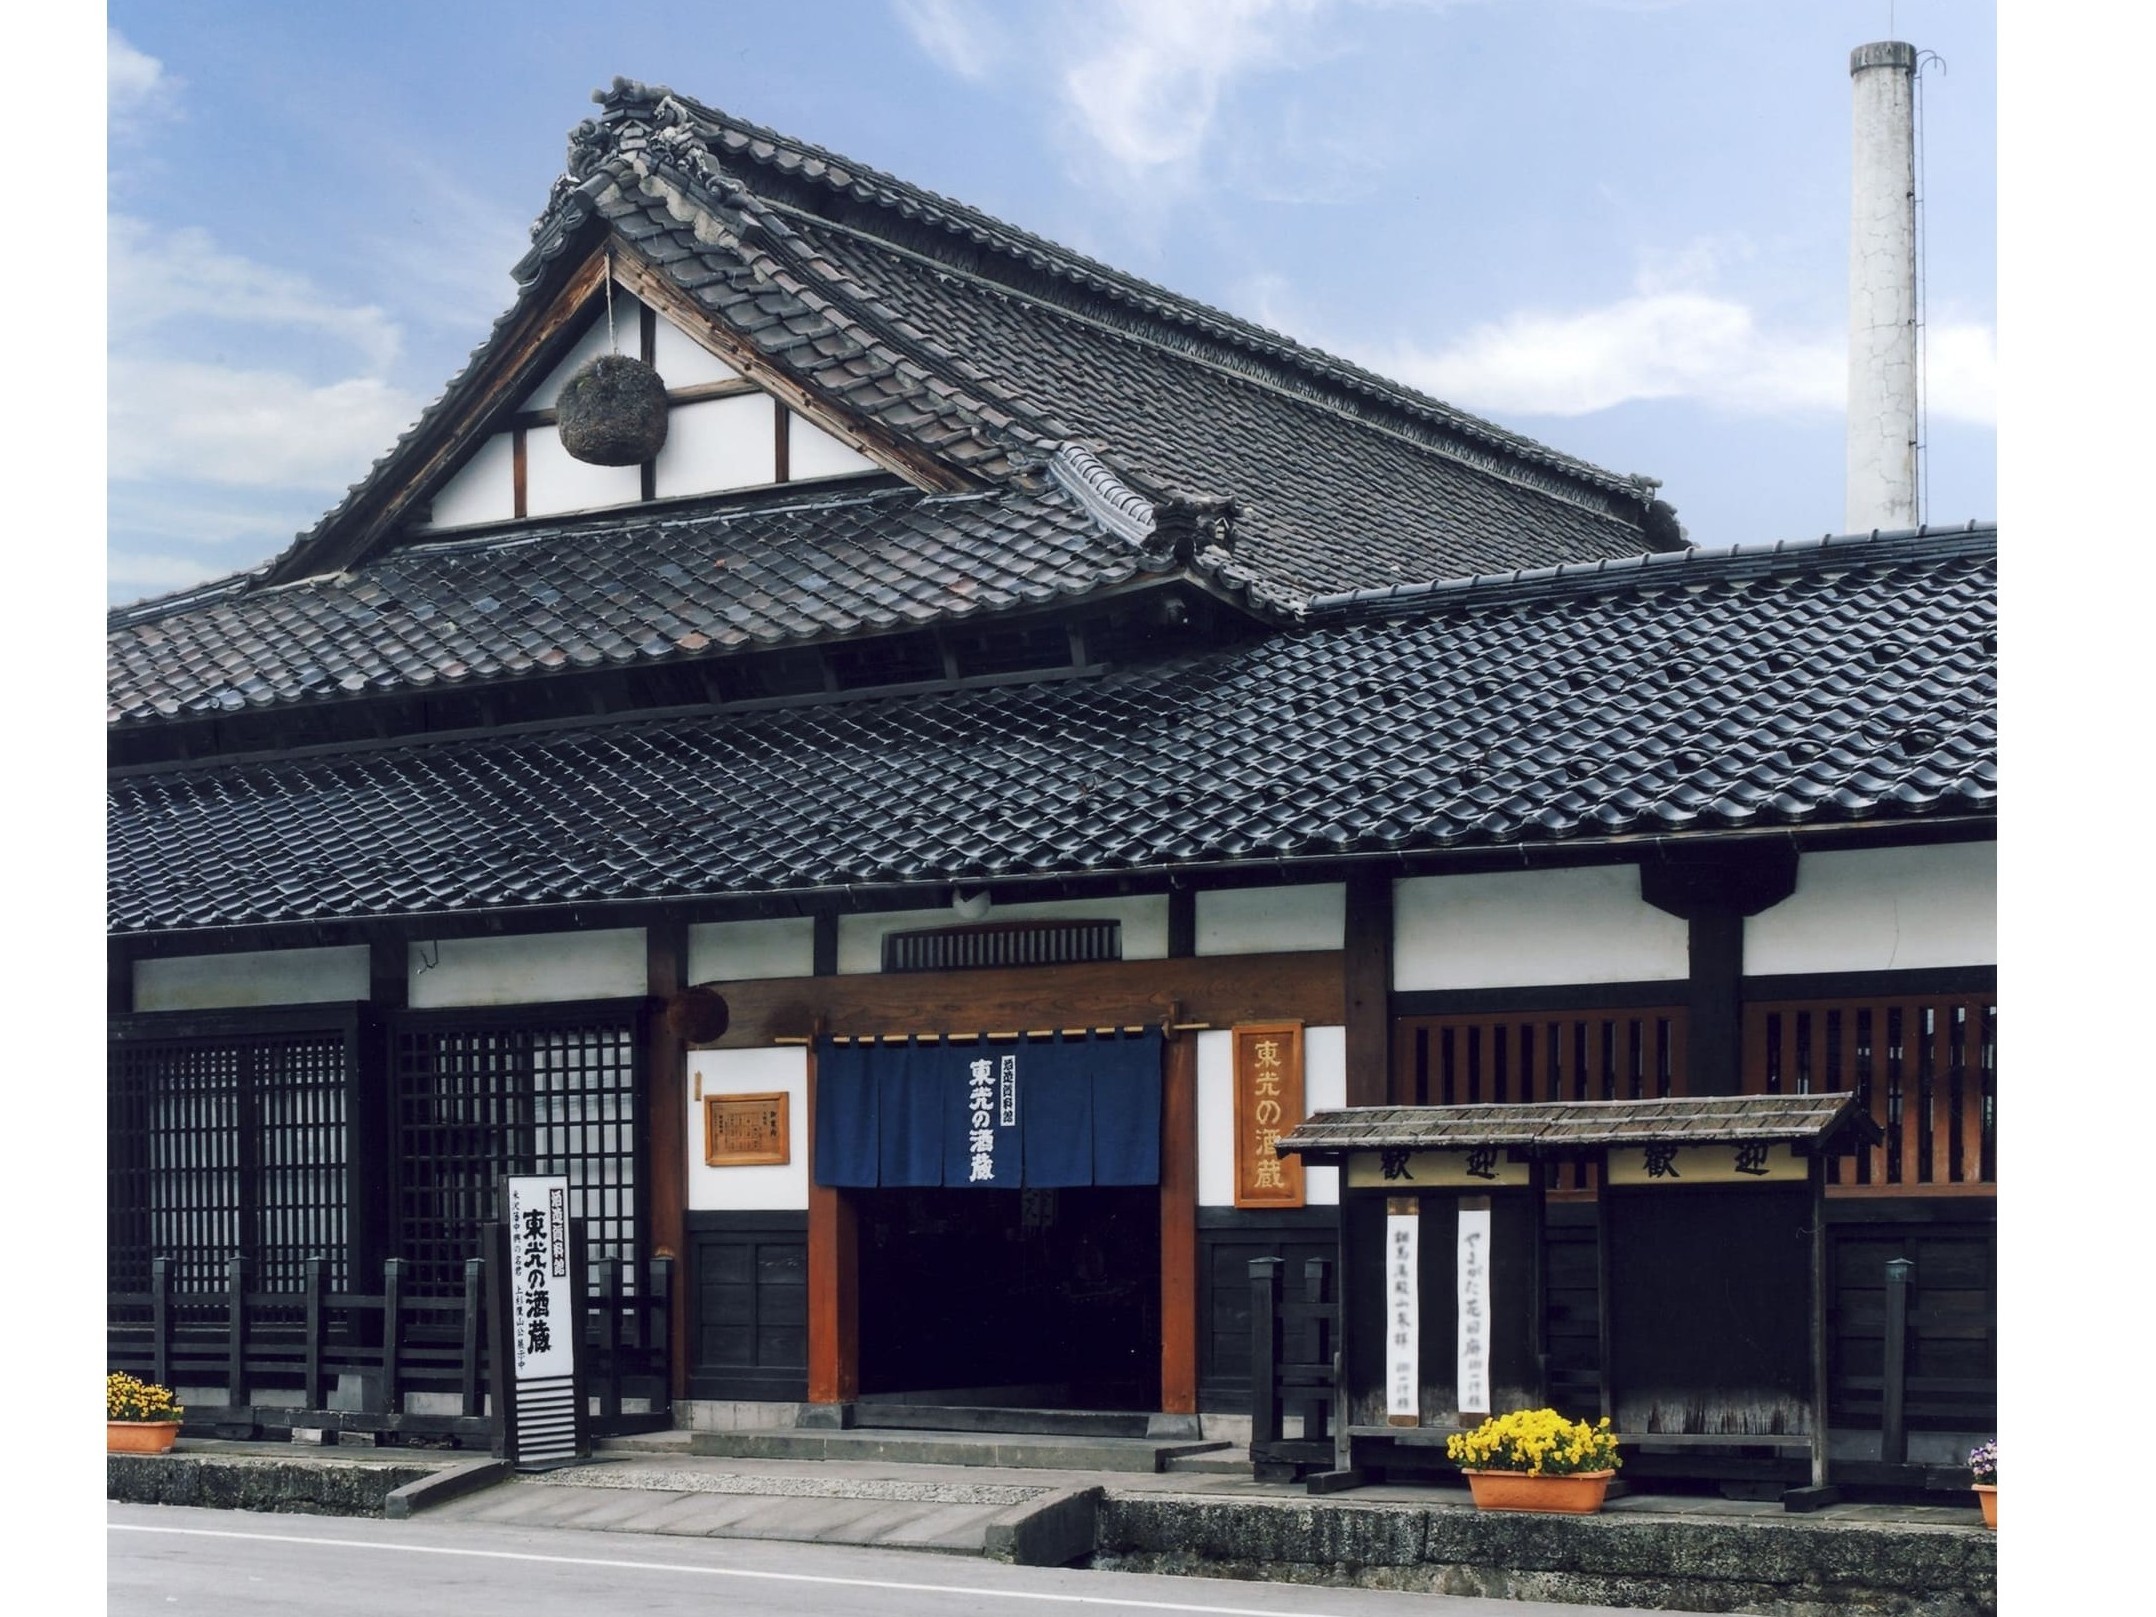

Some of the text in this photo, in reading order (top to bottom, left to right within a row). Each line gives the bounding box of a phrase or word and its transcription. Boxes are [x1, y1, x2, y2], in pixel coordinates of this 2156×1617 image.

[969, 1058, 996, 1182] 東光の酒蔵
[1254, 1040, 1285, 1188] 東光の酒蔵
[523, 1208, 551, 1354] 東光の酒蔵
